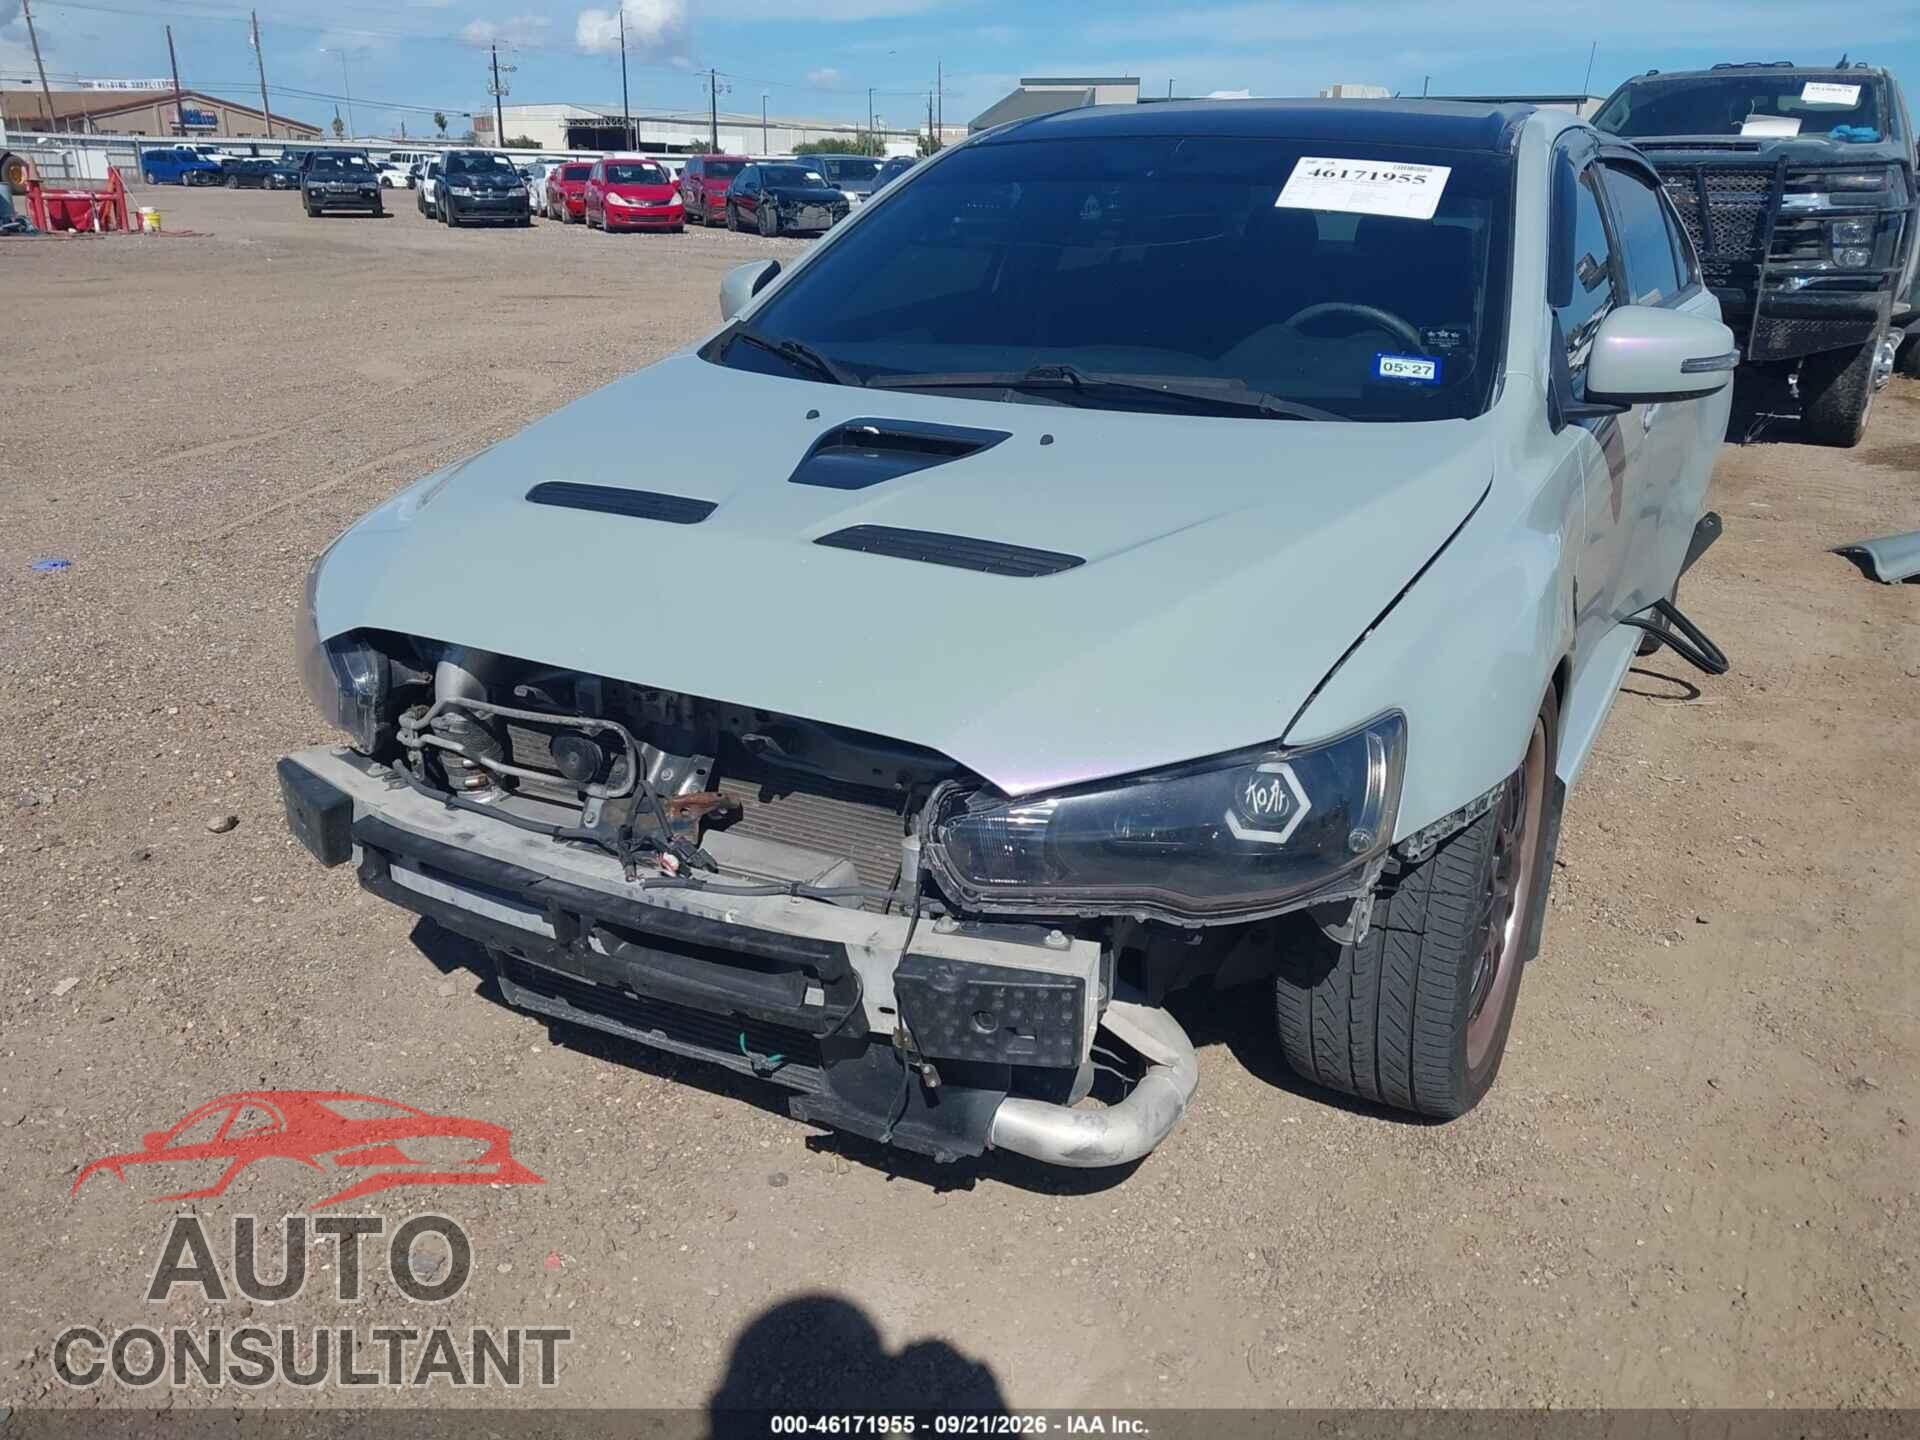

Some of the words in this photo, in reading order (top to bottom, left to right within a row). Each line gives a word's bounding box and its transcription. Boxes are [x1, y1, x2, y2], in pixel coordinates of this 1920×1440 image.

[1307, 167, 1428, 185] 46171955
[1383, 362, 1403, 373] 05
[1412, 365, 1433, 376] 27
